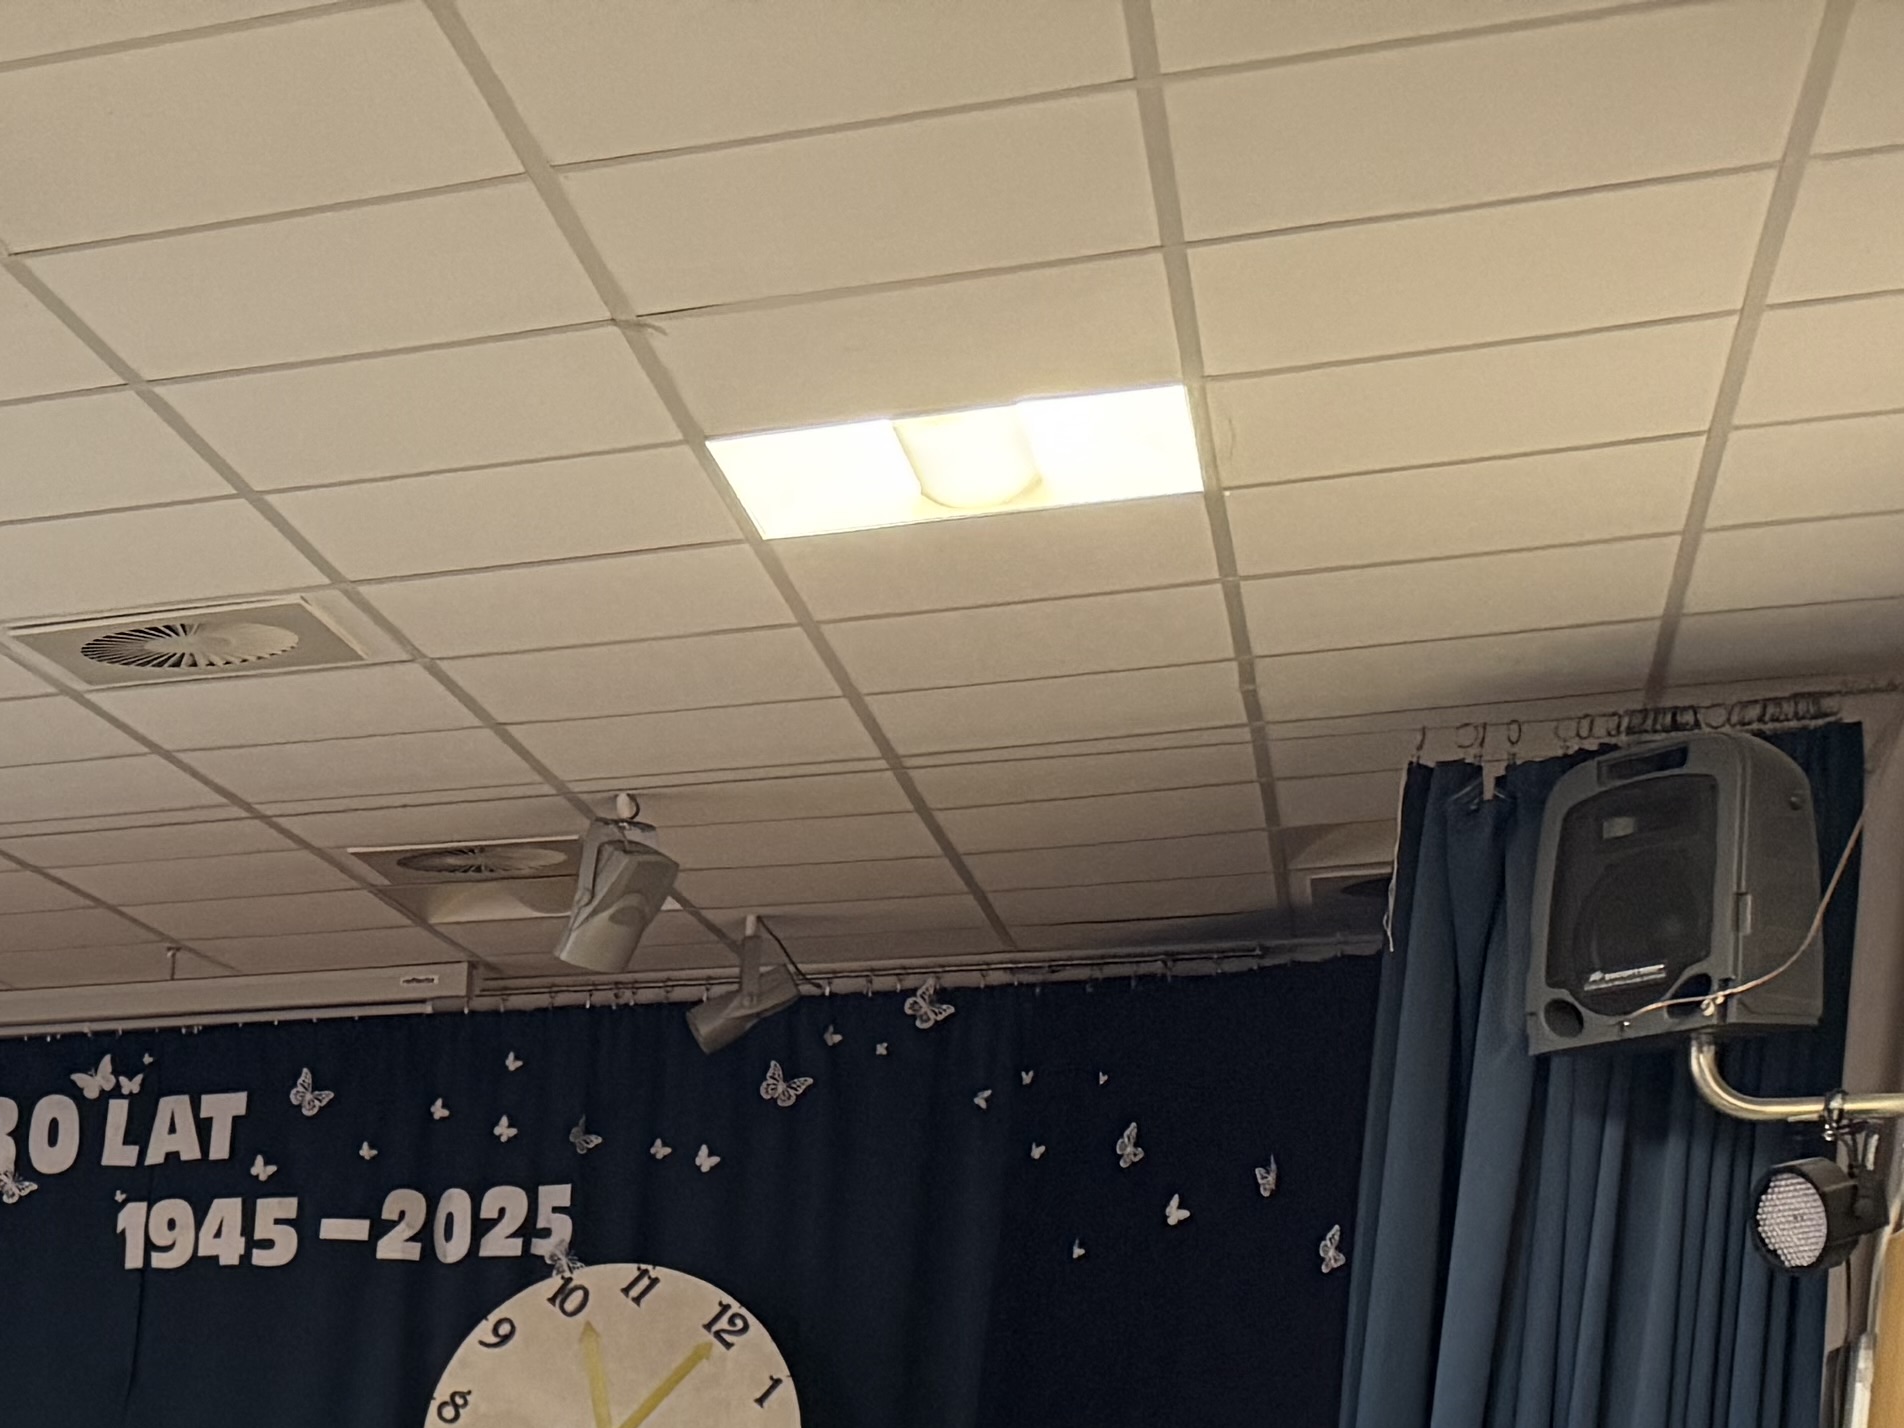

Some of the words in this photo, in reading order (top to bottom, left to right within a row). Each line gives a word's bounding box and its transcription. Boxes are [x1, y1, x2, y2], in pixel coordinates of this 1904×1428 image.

[101, 1091, 247, 1166] LAT
[117, 1197, 298, 1270] 1945
[547, 1275, 590, 1318] 10
[621, 1266, 660, 1307] 11
[479, 1317, 517, 1349] 9
[701, 1301, 750, 1349] 12
[437, 1390, 471, 1424] 8
[754, 1375, 784, 1408] 1
